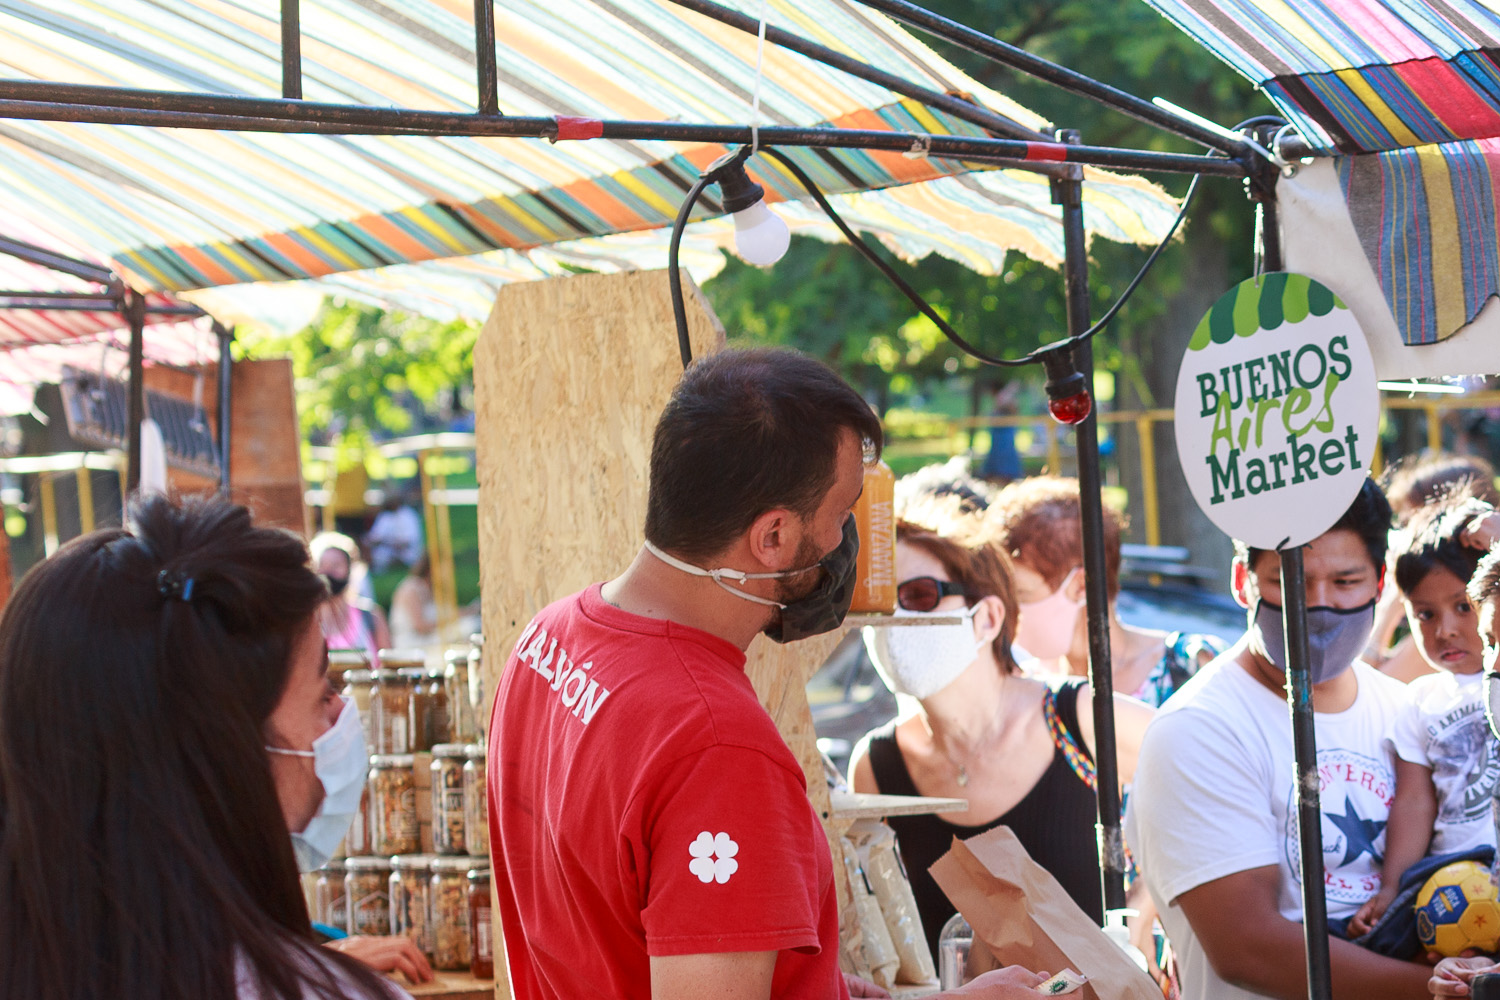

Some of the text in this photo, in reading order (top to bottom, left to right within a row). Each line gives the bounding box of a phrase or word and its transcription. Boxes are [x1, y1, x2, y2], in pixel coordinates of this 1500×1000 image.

[1196, 335, 1352, 418] BUENOS
[1210, 372, 1340, 455] Aires
[1205, 425, 1362, 505] Market
